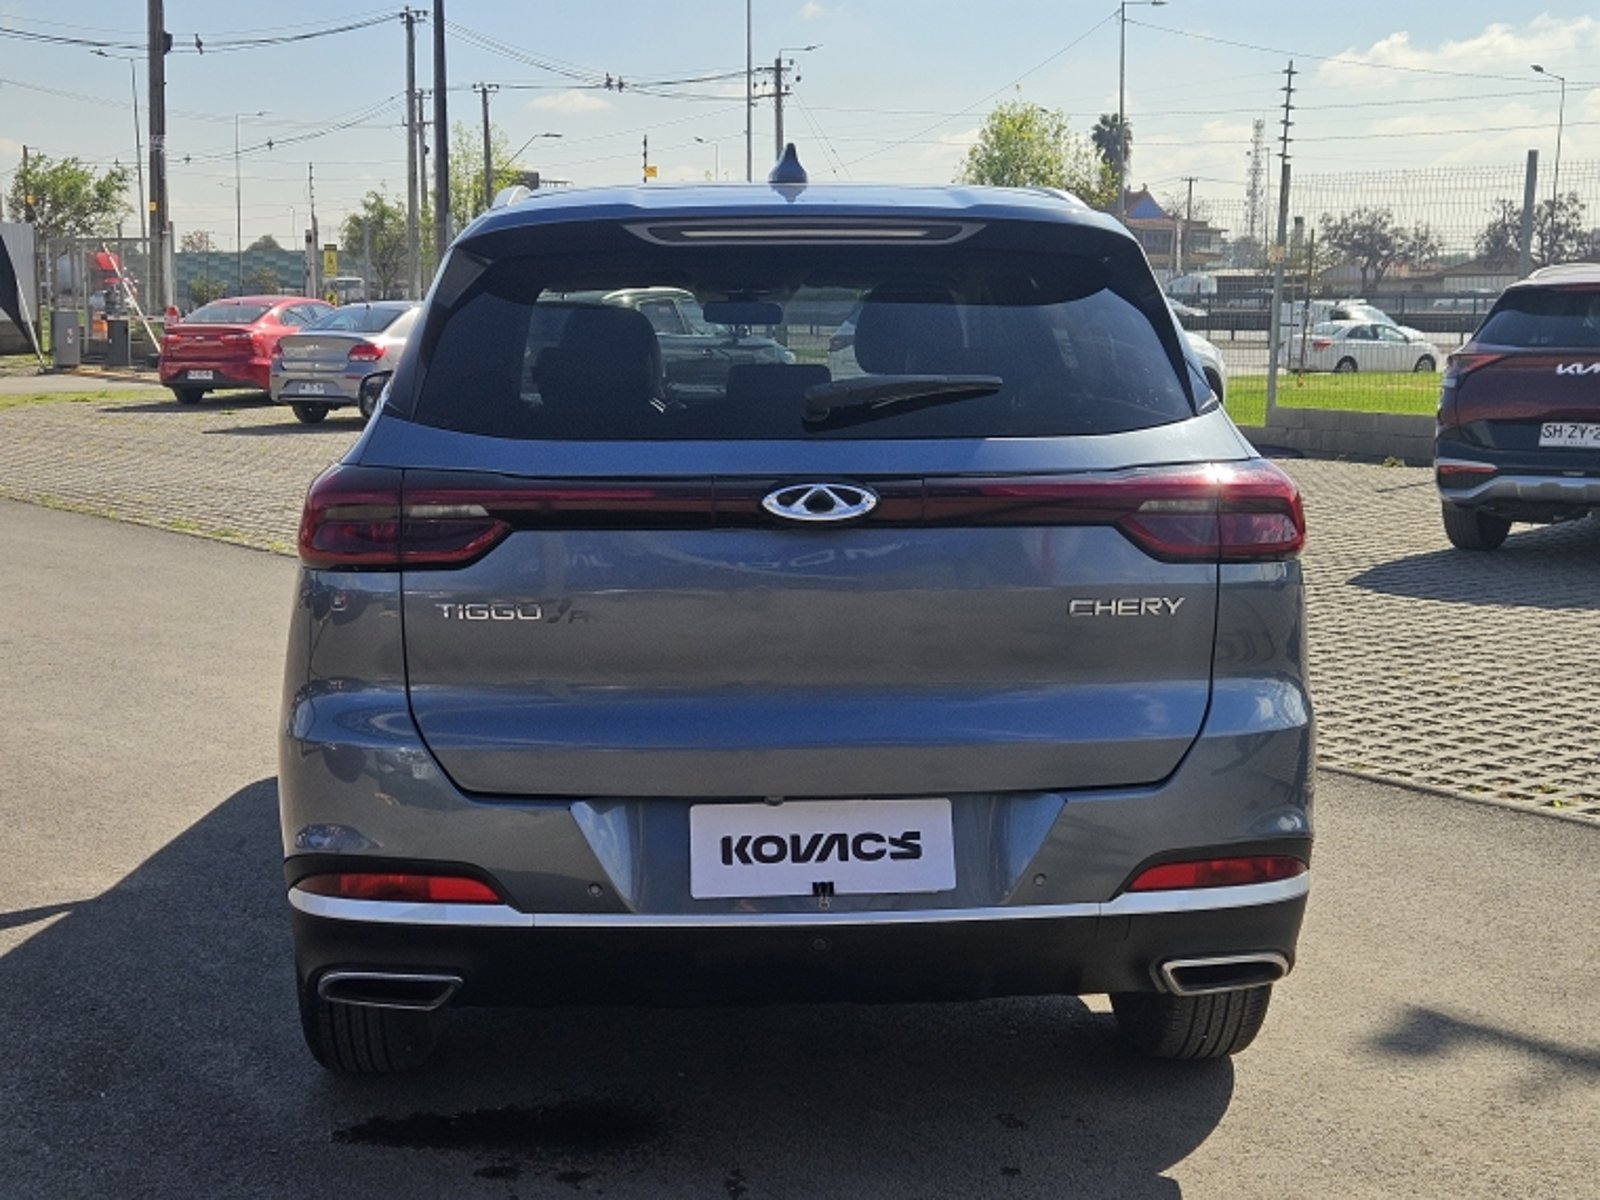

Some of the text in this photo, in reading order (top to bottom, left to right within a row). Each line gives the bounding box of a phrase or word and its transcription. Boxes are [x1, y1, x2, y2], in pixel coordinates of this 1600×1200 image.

[434, 603, 542, 621] TIGGO
[1068, 597, 1185, 617] CHERY
[720, 831, 922, 866] KOVACS
